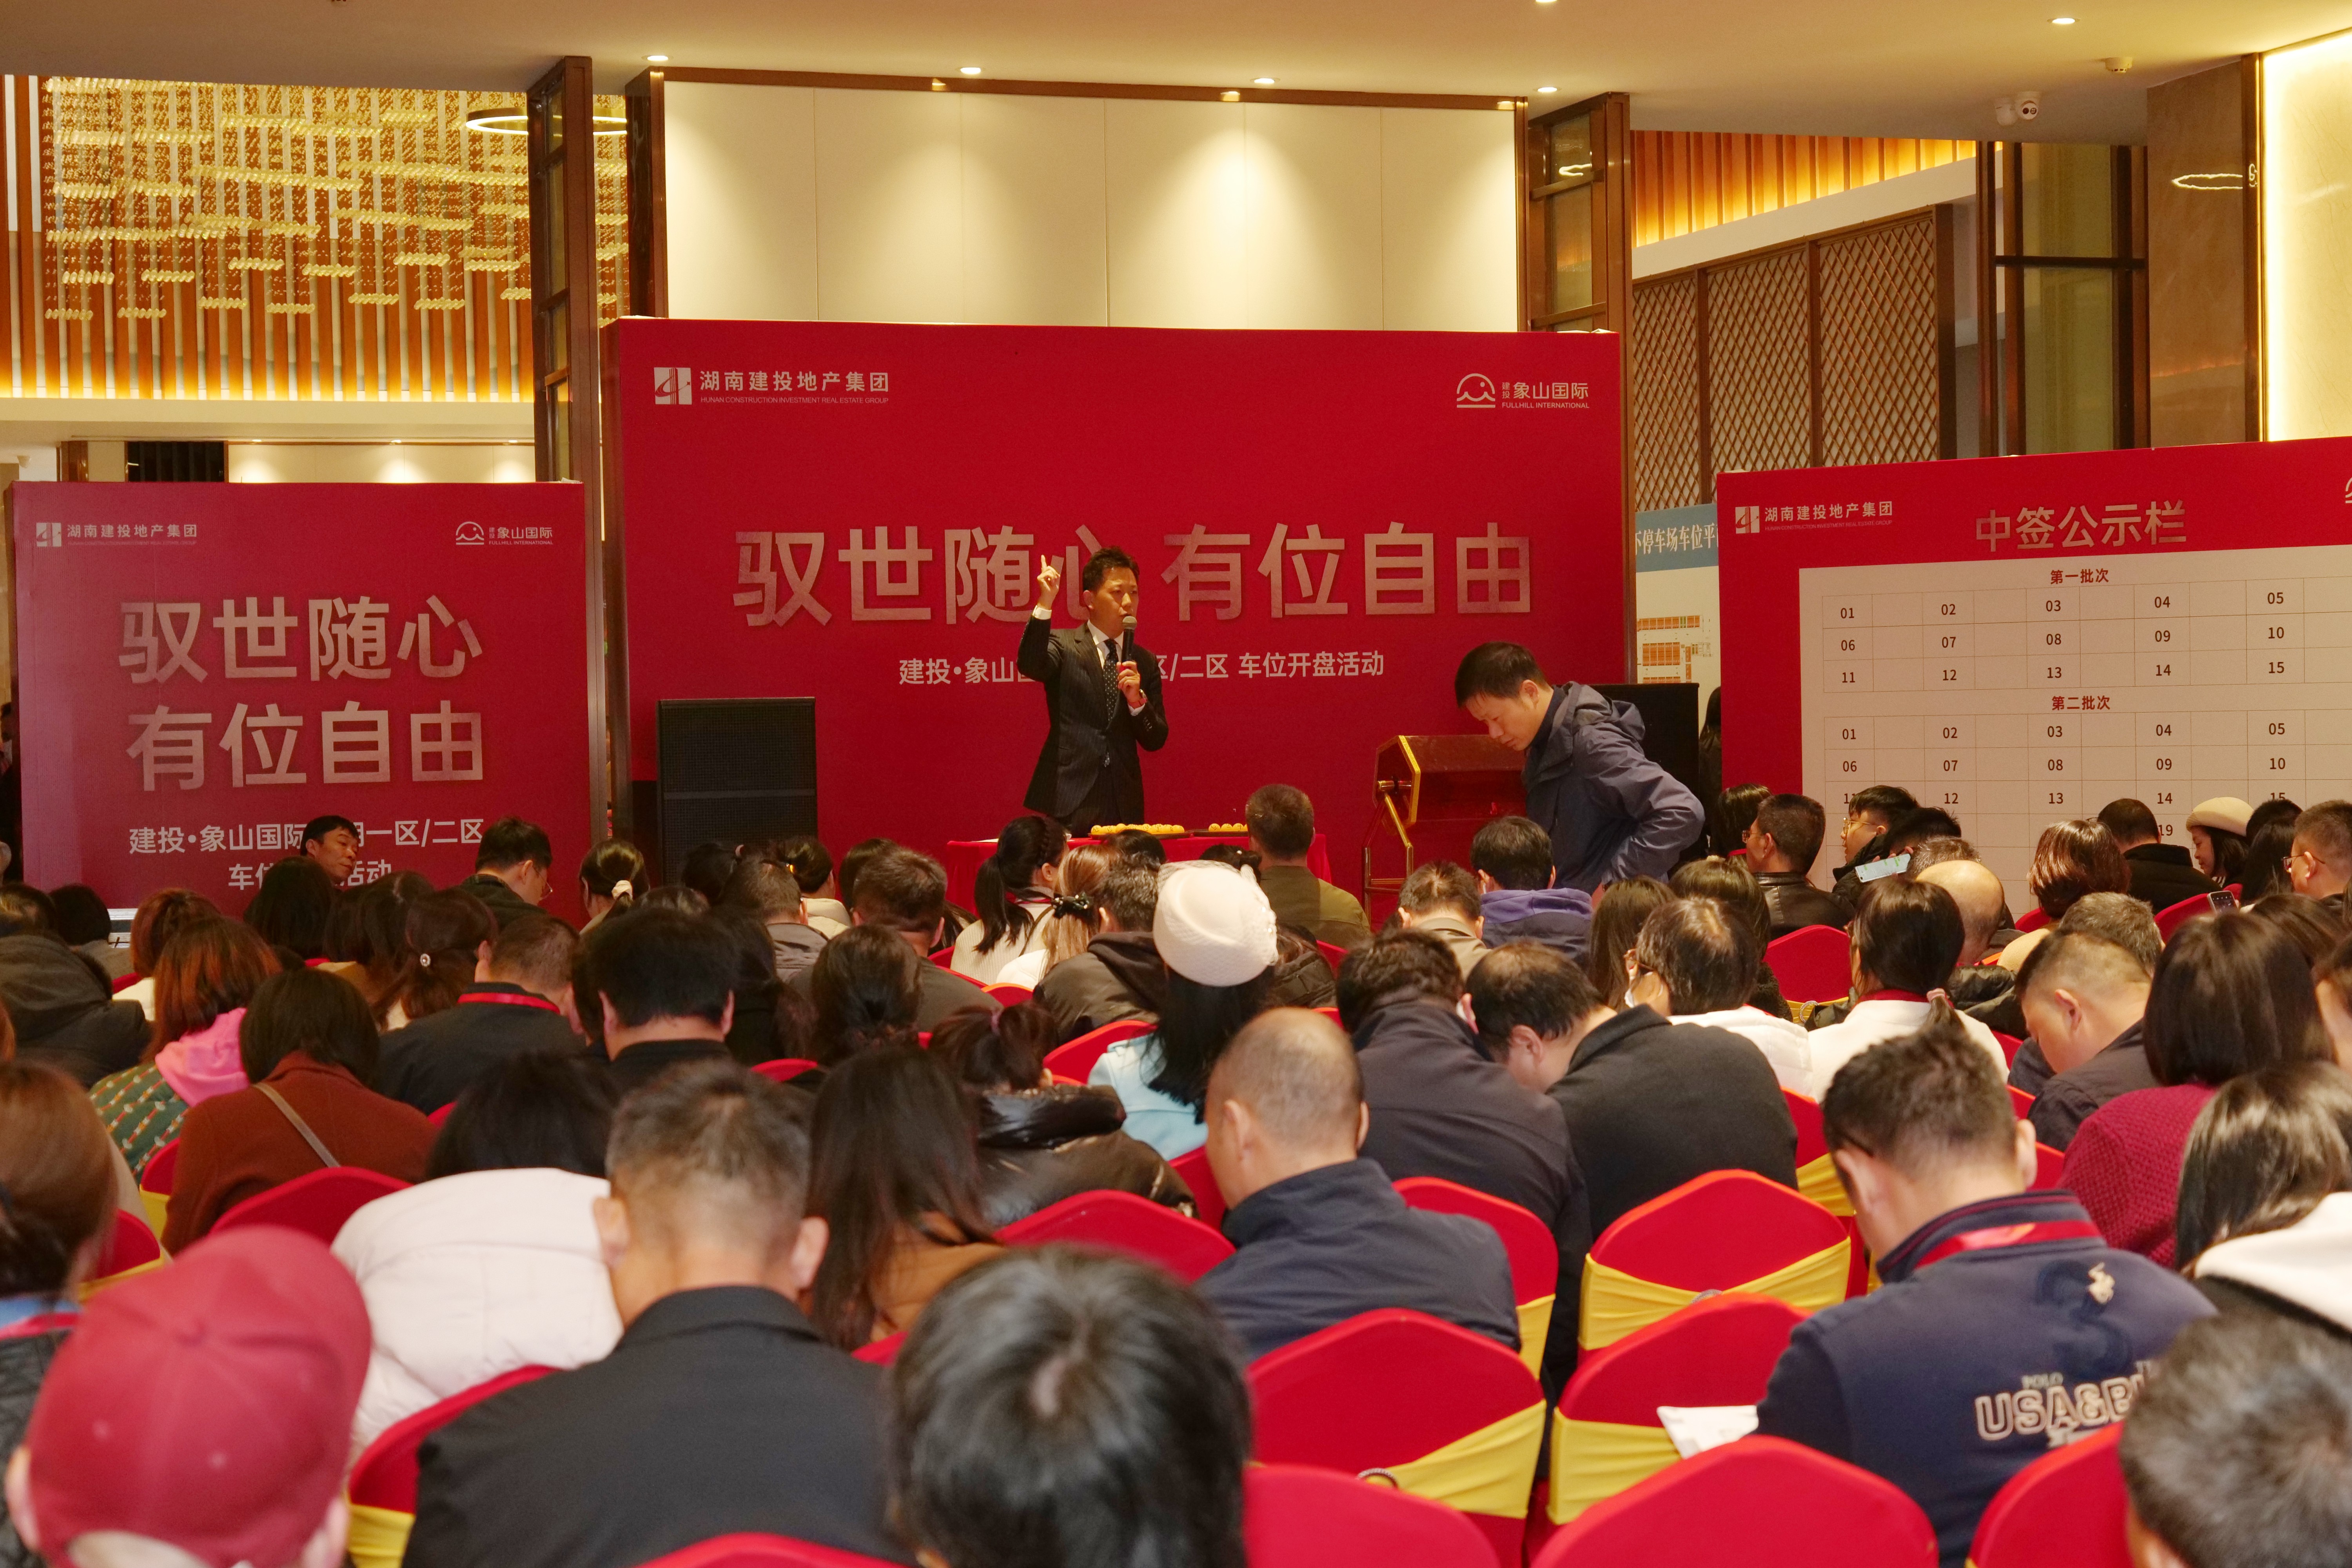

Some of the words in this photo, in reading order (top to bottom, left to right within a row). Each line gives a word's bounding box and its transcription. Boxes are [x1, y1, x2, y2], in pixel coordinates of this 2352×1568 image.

[700, 370, 888, 392] 湖南建投地产集团
[1513, 382, 1588, 399] 象山国际
[1765, 501, 1892, 522] 湖南建投地产集团
[67, 524, 197, 538] 湖南建投地产集团
[497, 527, 552, 539] 象山国际
[1976, 499, 2187, 552] 中签公示栏
[1635, 522, 1719, 555] 下停车场车位平
[1161, 521, 1531, 621] 有位自由
[2051, 568, 2109, 584] 第一批次
[1840, 608, 1855, 619] 01
[1941, 604, 1956, 615] 02
[2046, 600, 2061, 612] 03
[2154, 596, 2171, 608] 04
[2267, 592, 2284, 604] 05
[118, 595, 483, 684] 驭世随心
[1841, 639, 1855, 651] 06
[1942, 637, 1956, 648] 07
[2046, 633, 2062, 645] 08
[2155, 630, 2171, 642] 09
[2268, 627, 2284, 639] 10
[1238, 650, 1384, 679] 车位开盘活动
[1842, 672, 1855, 683] 11
[1943, 669, 1957, 681] 12
[2047, 667, 2062, 679] 13
[2156, 664, 2171, 676] 14
[2269, 662, 2285, 673] 15
[2052, 695, 2110, 711] 第二批次
[1842, 728, 1856, 740] 01
[1943, 727, 1958, 739] 02
[2047, 726, 2063, 737] 03
[2156, 724, 2172, 736] 04
[2269, 723, 2285, 735] 05
[126, 700, 483, 791] 有位自由
[1843, 761, 1857, 772] 06
[1943, 760, 1958, 771] 07
[2048, 759, 2063, 771] 08
[2156, 758, 2172, 770] 09
[2270, 758, 2285, 769] 10
[1844, 793, 1855, 804] 1
[1944, 793, 1959, 804] 12
[2049, 793, 2063, 804] 13
[2157, 793, 2172, 804] 14
[2158, 824, 2173, 836] 19
